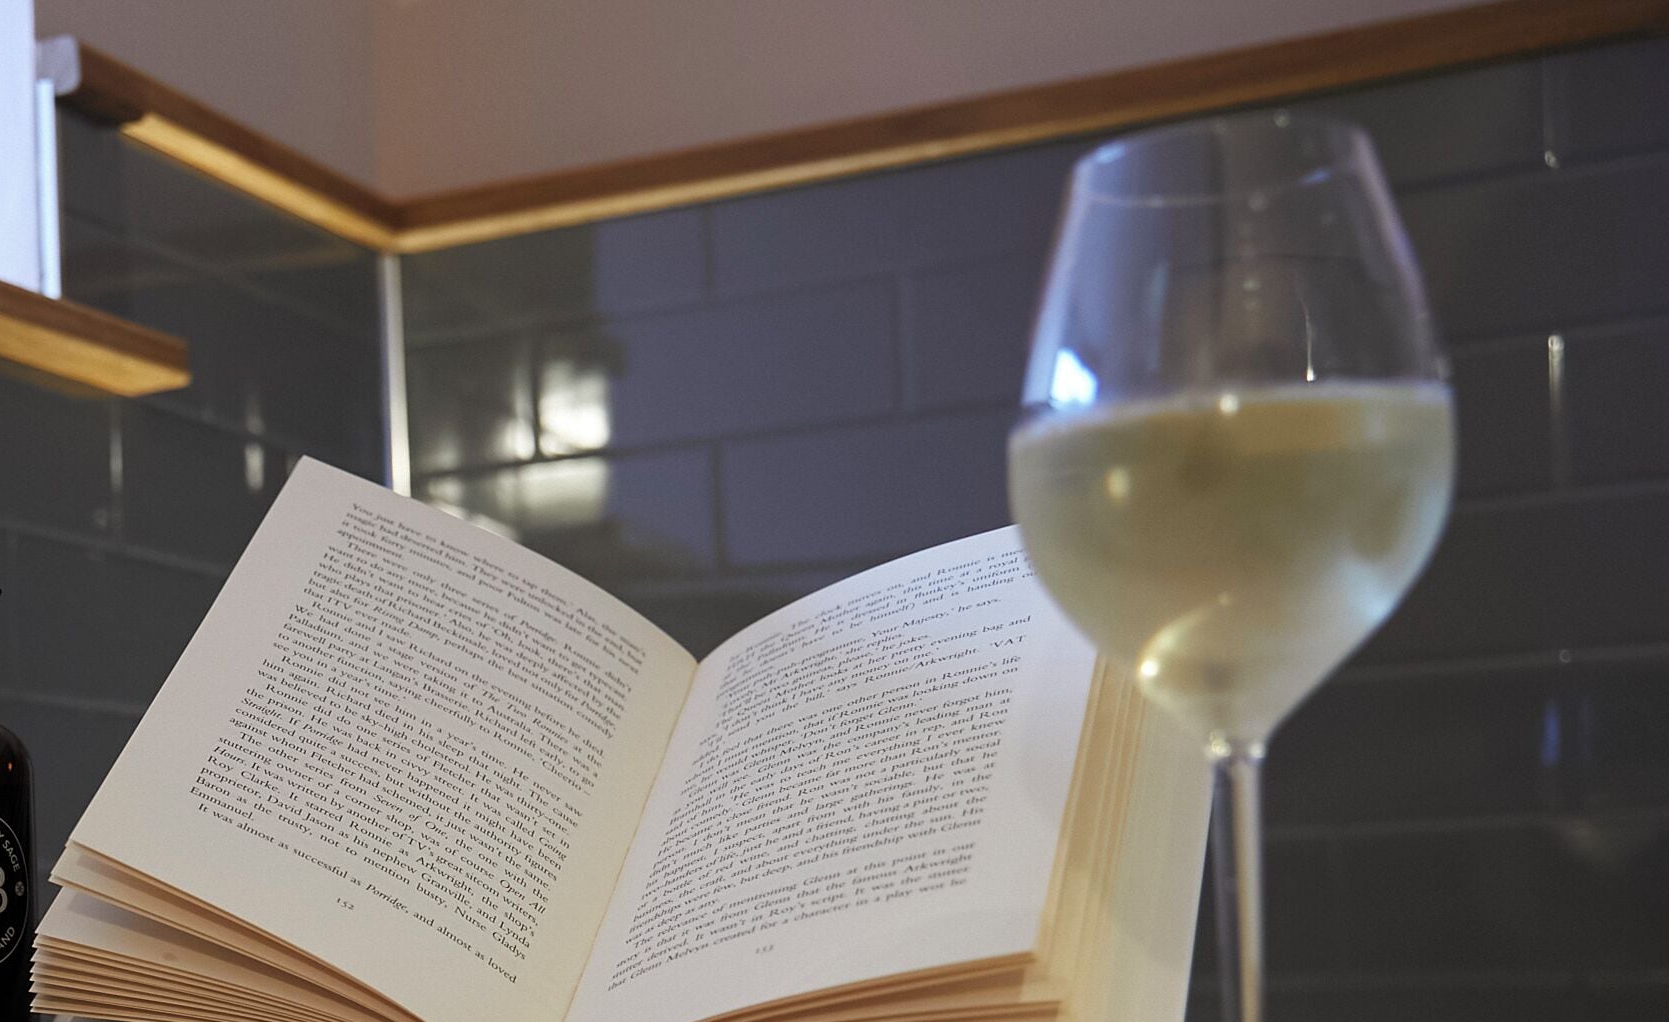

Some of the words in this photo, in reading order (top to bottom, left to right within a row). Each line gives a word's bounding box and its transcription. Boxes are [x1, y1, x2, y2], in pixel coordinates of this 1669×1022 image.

[303, 587, 324, 601] that
[327, 596, 353, 611] ITV
[354, 610, 379, 623] ever
[311, 600, 353, 623] Ronnie
[355, 621, 377, 633] and
[386, 634, 406, 646] saw
[408, 642, 453, 668] Richard
[454, 666, 469, 676] on
[471, 673, 489, 686] the
[490, 684, 532, 711] evening
[533, 705, 566, 730] before
[567, 726, 581, 739] he
[262, 658, 285, 674] him
[325, 685, 372, 711] Richard
[374, 708, 400, 724] died
[402, 720, 414, 732] in
[418, 727, 434, 742] his
[438, 740, 465, 758] sleep
[468, 755, 489, 771] that
[528, 788, 549, 807] The
[552, 807, 579, 828] cause
[281, 655, 324, 678] Ronnie
[327, 676, 347, 688] did
[350, 686, 370, 699] not
[373, 696, 391, 708] see
[394, 704, 417, 721] him
[420, 718, 432, 729] in
[512, 767, 530, 782] He
[532, 781, 562, 802] never
[564, 802, 583, 817] saw
[2, 839, 21, 873] SAGE
[195, 775, 231, 797] Baron
[236, 795, 248, 805] as
[253, 803, 273, 815] the
[319, 834, 340, 848] not
[345, 846, 358, 856] to
[363, 856, 411, 886] mention
[454, 905, 487, 932] Nurse
[492, 931, 526, 960] Gladys
[198, 802, 208, 813] It
[212, 810, 234, 824] was
[236, 822, 275, 843] almost
[277, 841, 289, 850] as
[293, 848, 348, 879] successful
[350, 877, 361, 886] as
[413, 912, 435, 927] and
[436, 926, 472, 952] almost
[474, 951, 485, 961] as
[487, 957, 517, 984] loved
[207, 755, 235, 773] Roy
[288, 791, 299, 802] It
[304, 800, 344, 823] starred
[349, 820, 393, 848] Ronnie
[398, 847, 409, 857] as
[481, 896, 499, 911] the
[218, 737, 273, 766] stuttering
[276, 762, 314, 782] owner
[317, 781, 334, 790] of
[333, 788, 340, 796] a
[344, 794, 383, 815] corner
[421, 832, 440, 847] was
[444, 846, 460, 857] of
[460, 856, 495, 880] course
[499, 879, 526, 901] Open
[528, 902, 547, 915] All
[239, 731, 263, 747] The
[267, 746, 300, 763] other
[304, 762, 334, 780] series
[339, 777, 367, 796] from
[372, 794, 404, 814] Seven
[408, 814, 423, 822] of
[455, 838, 473, 853] the
[478, 853, 499, 869] one
[504, 868, 527, 888] with
[532, 887, 549, 904] the
[251, 761, 262, 772] It
[263, 768, 284, 782] was
[287, 779, 328, 803] written
[330, 797, 345, 811] by
[346, 808, 391, 833] another
[391, 831, 408, 840] of
[435, 855, 464, 875] great
[464, 872, 500, 898] sitcom
[266, 794, 303, 816] David
[301, 812, 335, 832] Jason
[338, 830, 350, 839] as
[352, 834, 370, 849] his
[372, 847, 418, 874] nephew
[476, 907, 497, 924] and
[499, 920, 530, 949] Lynda
